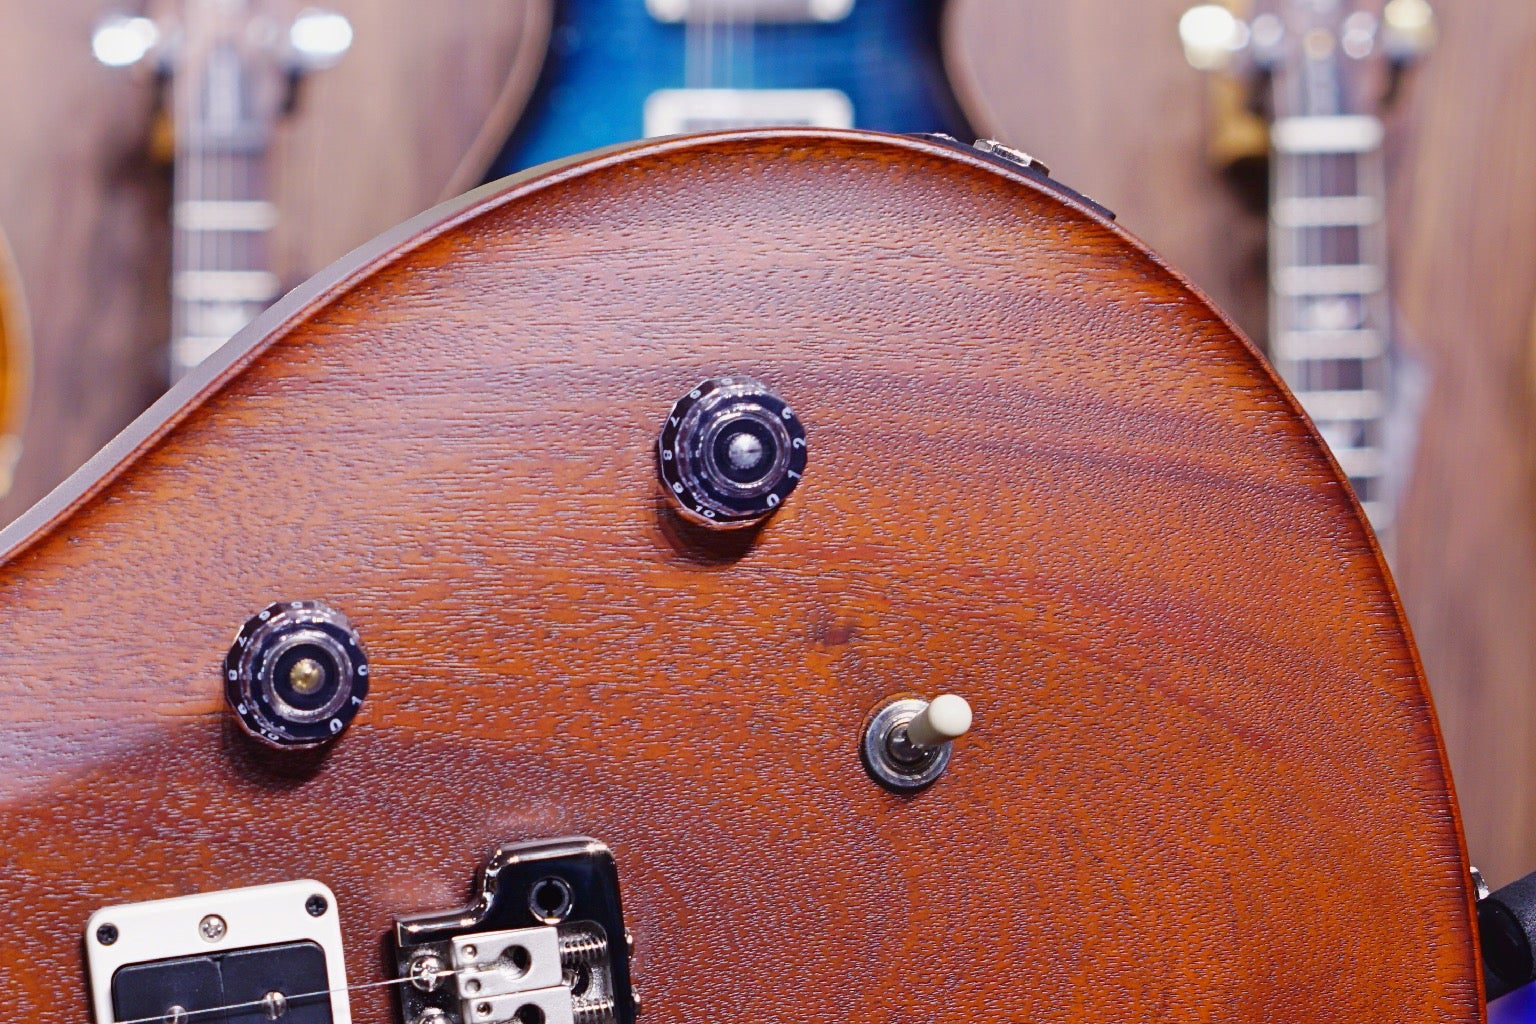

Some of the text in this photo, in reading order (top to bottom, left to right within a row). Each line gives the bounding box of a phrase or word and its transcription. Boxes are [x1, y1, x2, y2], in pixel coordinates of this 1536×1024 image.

[670, 416, 680, 427] 7
[792, 437, 806, 449] 2
[663, 449, 673, 460] 8
[787, 469, 800, 479] 1
[695, 504, 716, 518] 10
